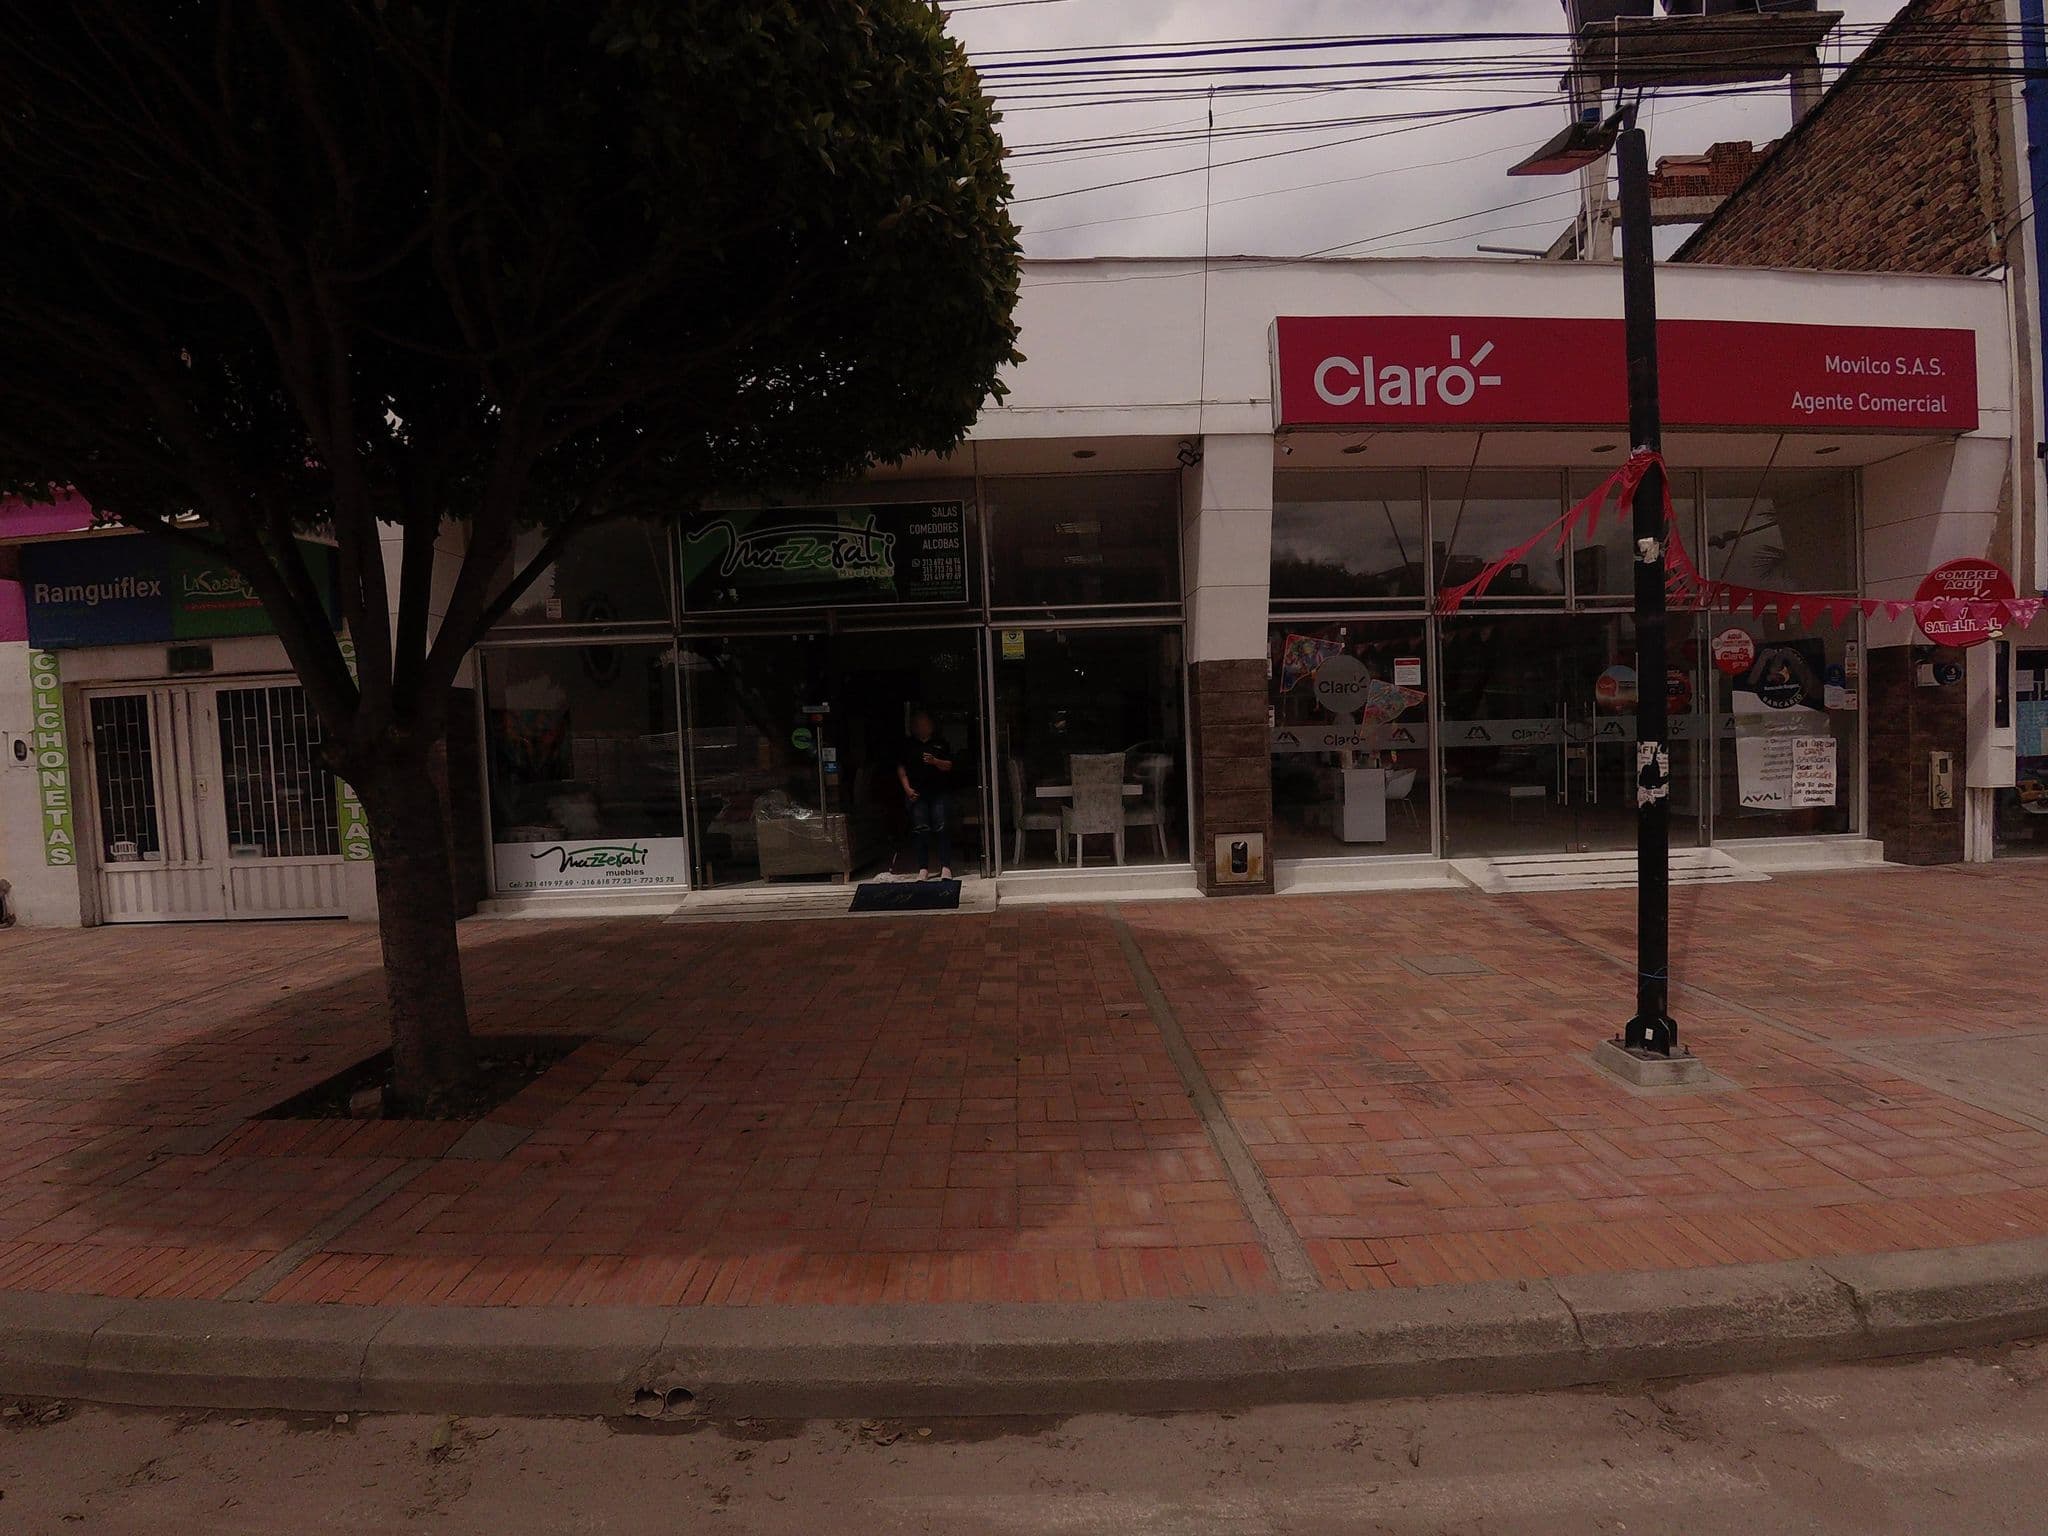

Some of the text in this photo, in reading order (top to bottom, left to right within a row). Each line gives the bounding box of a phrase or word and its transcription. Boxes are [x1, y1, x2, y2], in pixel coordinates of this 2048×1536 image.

[1313, 340, 1495, 406] Claro
[1825, 354, 1946, 376] Movilco S.A.S.
[1791, 391, 1948, 414] Agente Comercial
[931, 505, 958, 518] SALAS
[909, 522, 959, 535] COMEDORES
[922, 538, 960, 550] ALCOBAS
[1934, 569, 1999, 580] COMPRE
[34, 577, 162, 606] Ramguiflex
[1924, 617, 2003, 634] SATELITL
[1318, 676, 1368, 694] Claro
[1323, 730, 1366, 746] Claro
[1511, 724, 1551, 741] Claro
[32, 653, 72, 864] COLCHONETAS
[1742, 792, 1782, 803] AVAL
[605, 868, 645, 877] muebles
